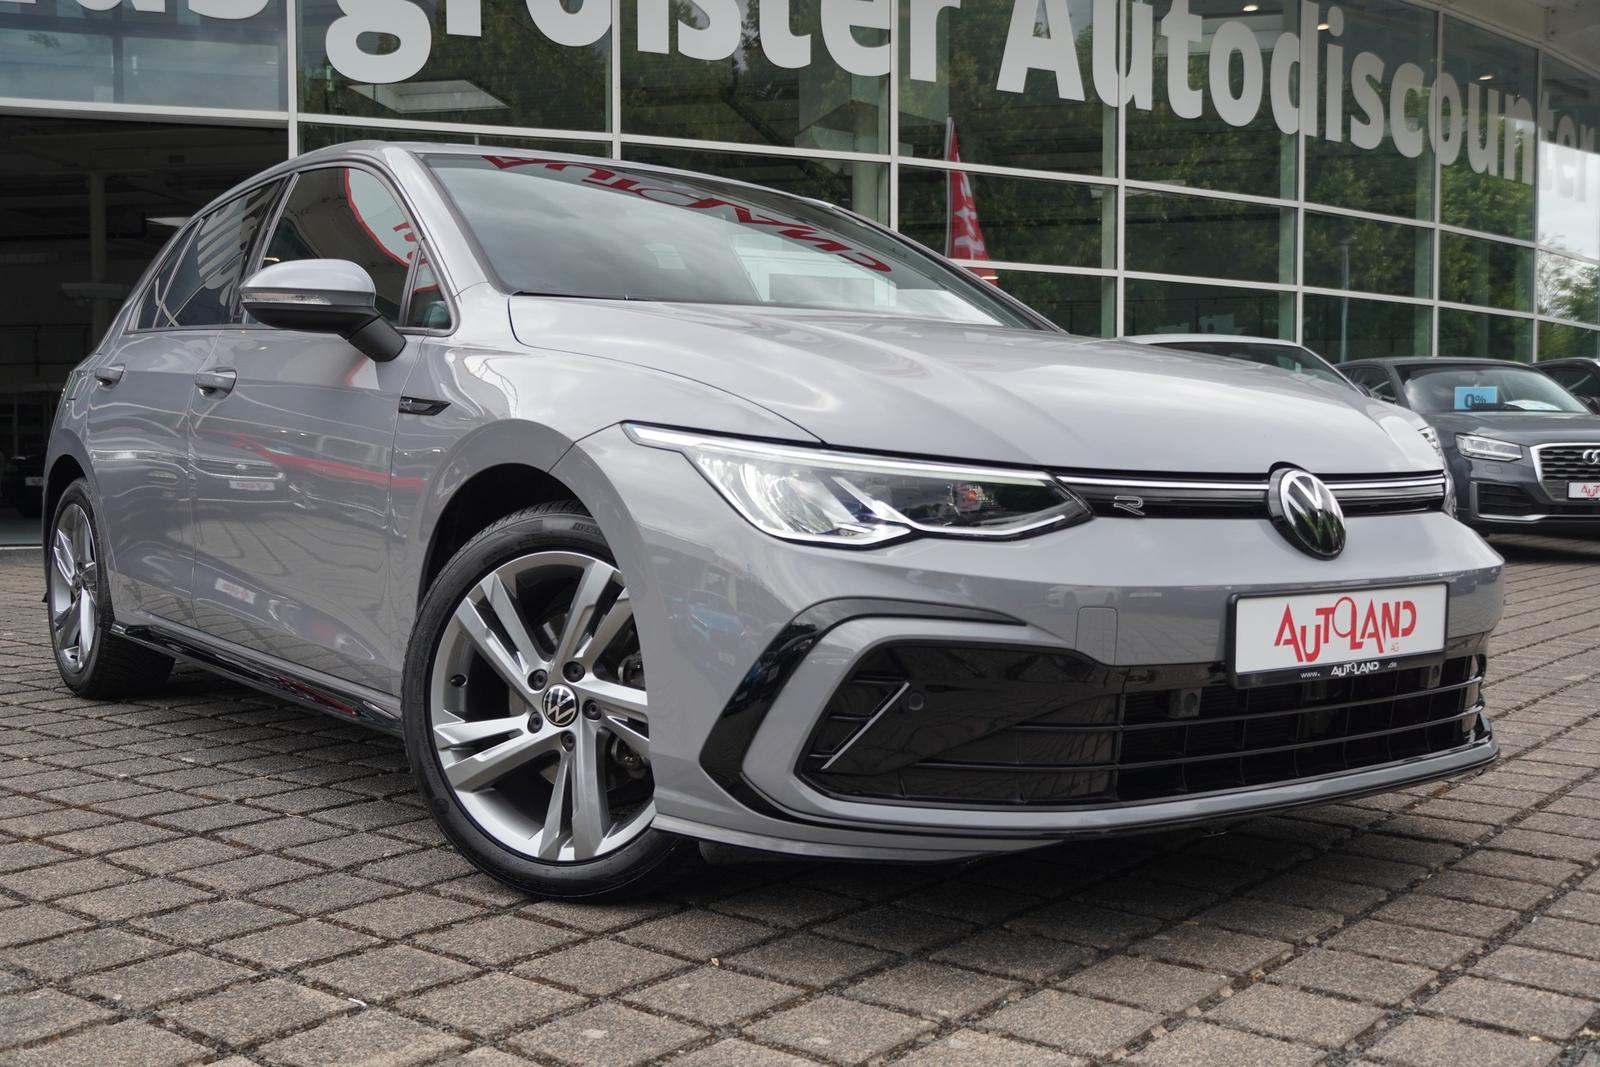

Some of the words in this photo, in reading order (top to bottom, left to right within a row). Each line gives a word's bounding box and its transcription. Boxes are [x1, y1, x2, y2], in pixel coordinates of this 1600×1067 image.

[1274, 596, 1417, 662] AUTOLAND
[1300, 671, 1321, 679] www.
[1330, 661, 1380, 677] AUTOLAND
